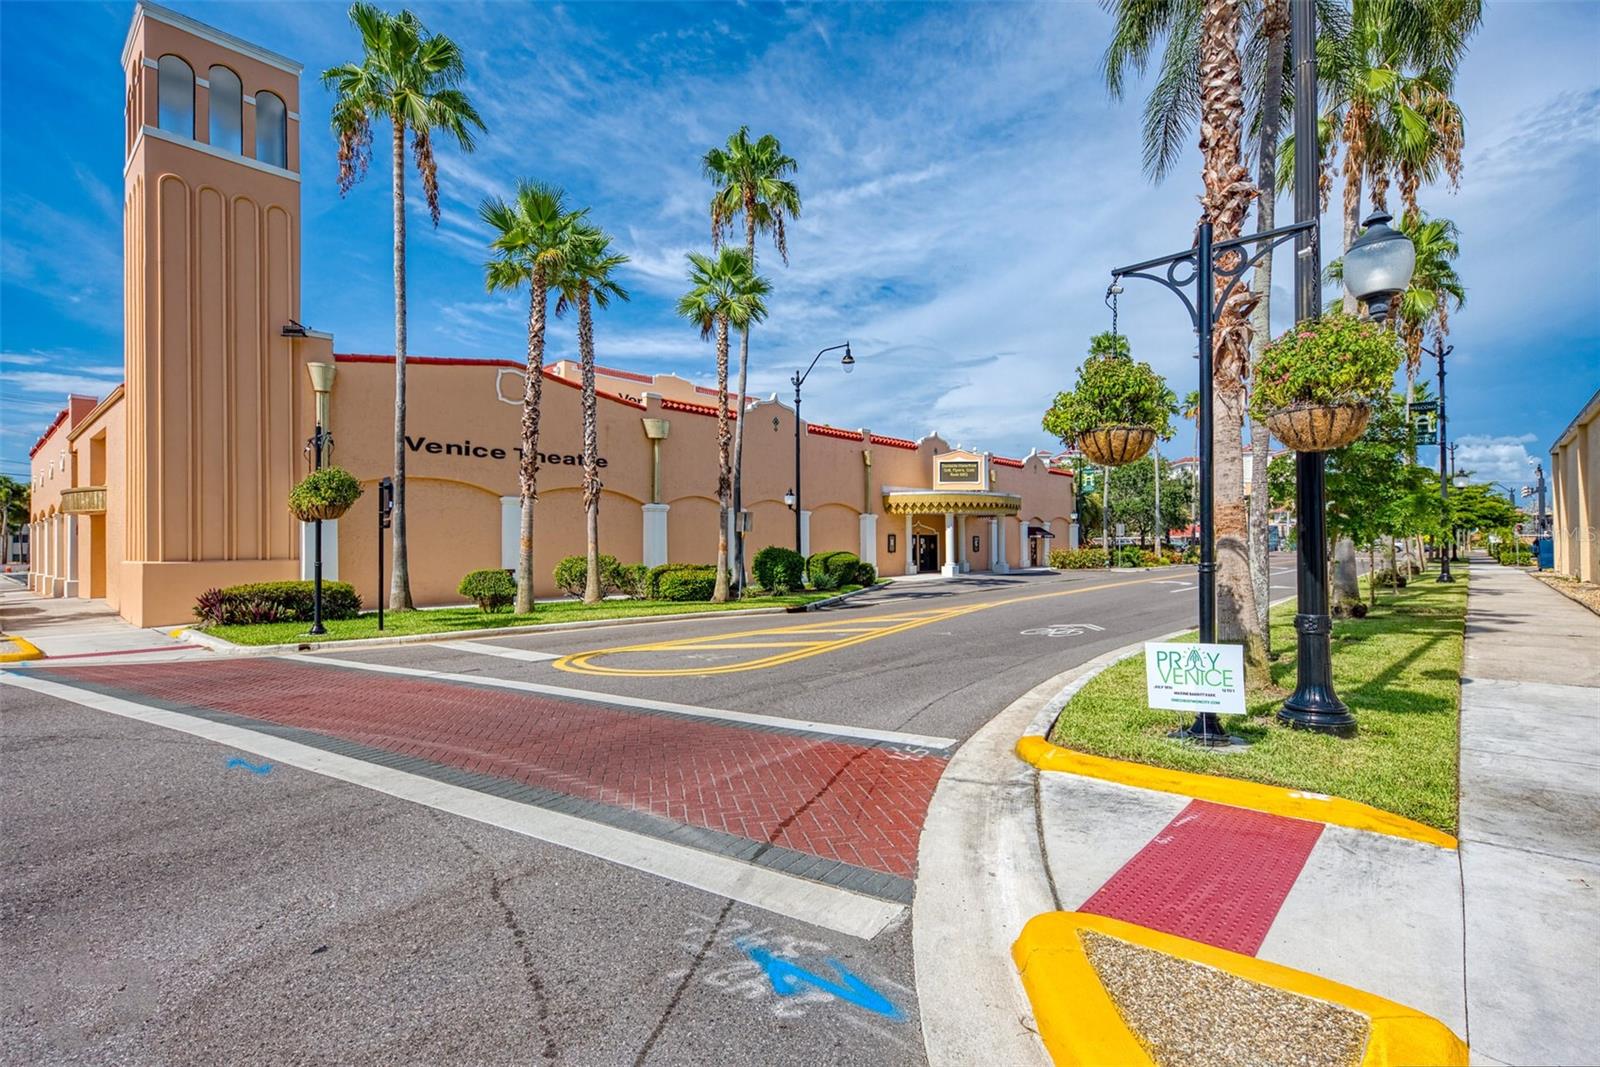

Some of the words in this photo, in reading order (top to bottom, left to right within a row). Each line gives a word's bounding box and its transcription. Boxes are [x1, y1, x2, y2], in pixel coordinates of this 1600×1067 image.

[405, 435, 506, 459] Venice
[513, 446, 609, 468] Theate
[1157, 667, 1233, 687] VENICE
